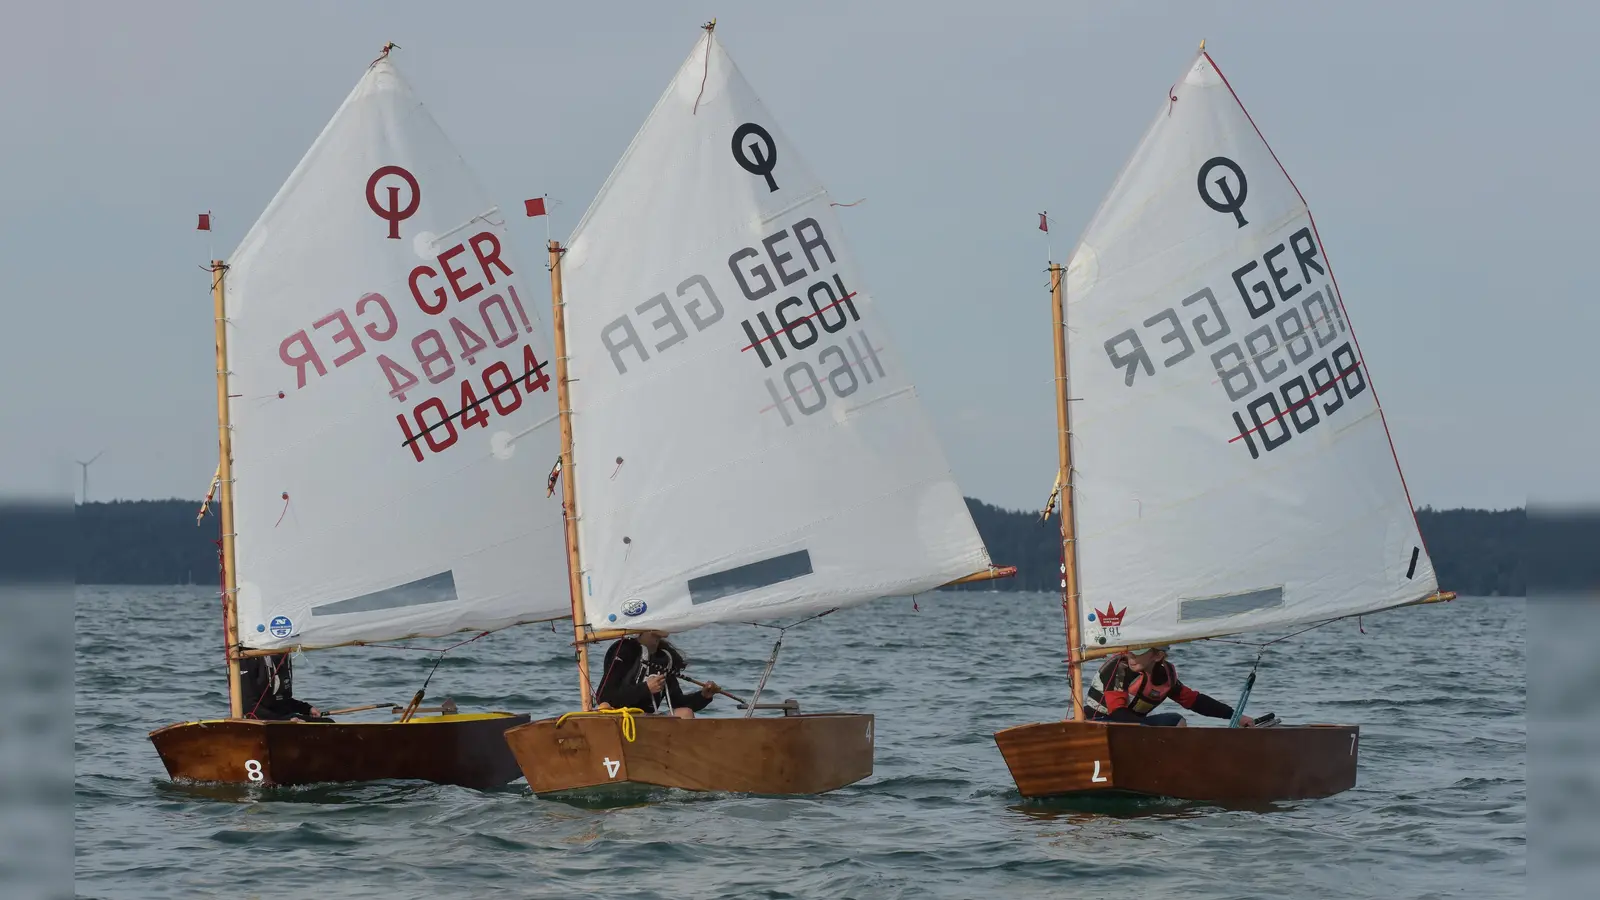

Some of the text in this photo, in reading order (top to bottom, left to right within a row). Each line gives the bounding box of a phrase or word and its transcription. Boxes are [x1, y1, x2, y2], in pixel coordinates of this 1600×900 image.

[408, 231, 514, 315] GER
[728, 217, 837, 301] GER
[1231, 226, 1325, 320] GER
[741, 273, 861, 368] 11601
[396, 344, 550, 462] 10484
[1232, 341, 1366, 460] 10898
[244, 759, 264, 782] 8
[602, 757, 620, 779] 4
[865, 720, 872, 743] 4
[1091, 760, 1107, 783] 7
[1349, 733, 1356, 756] 7
